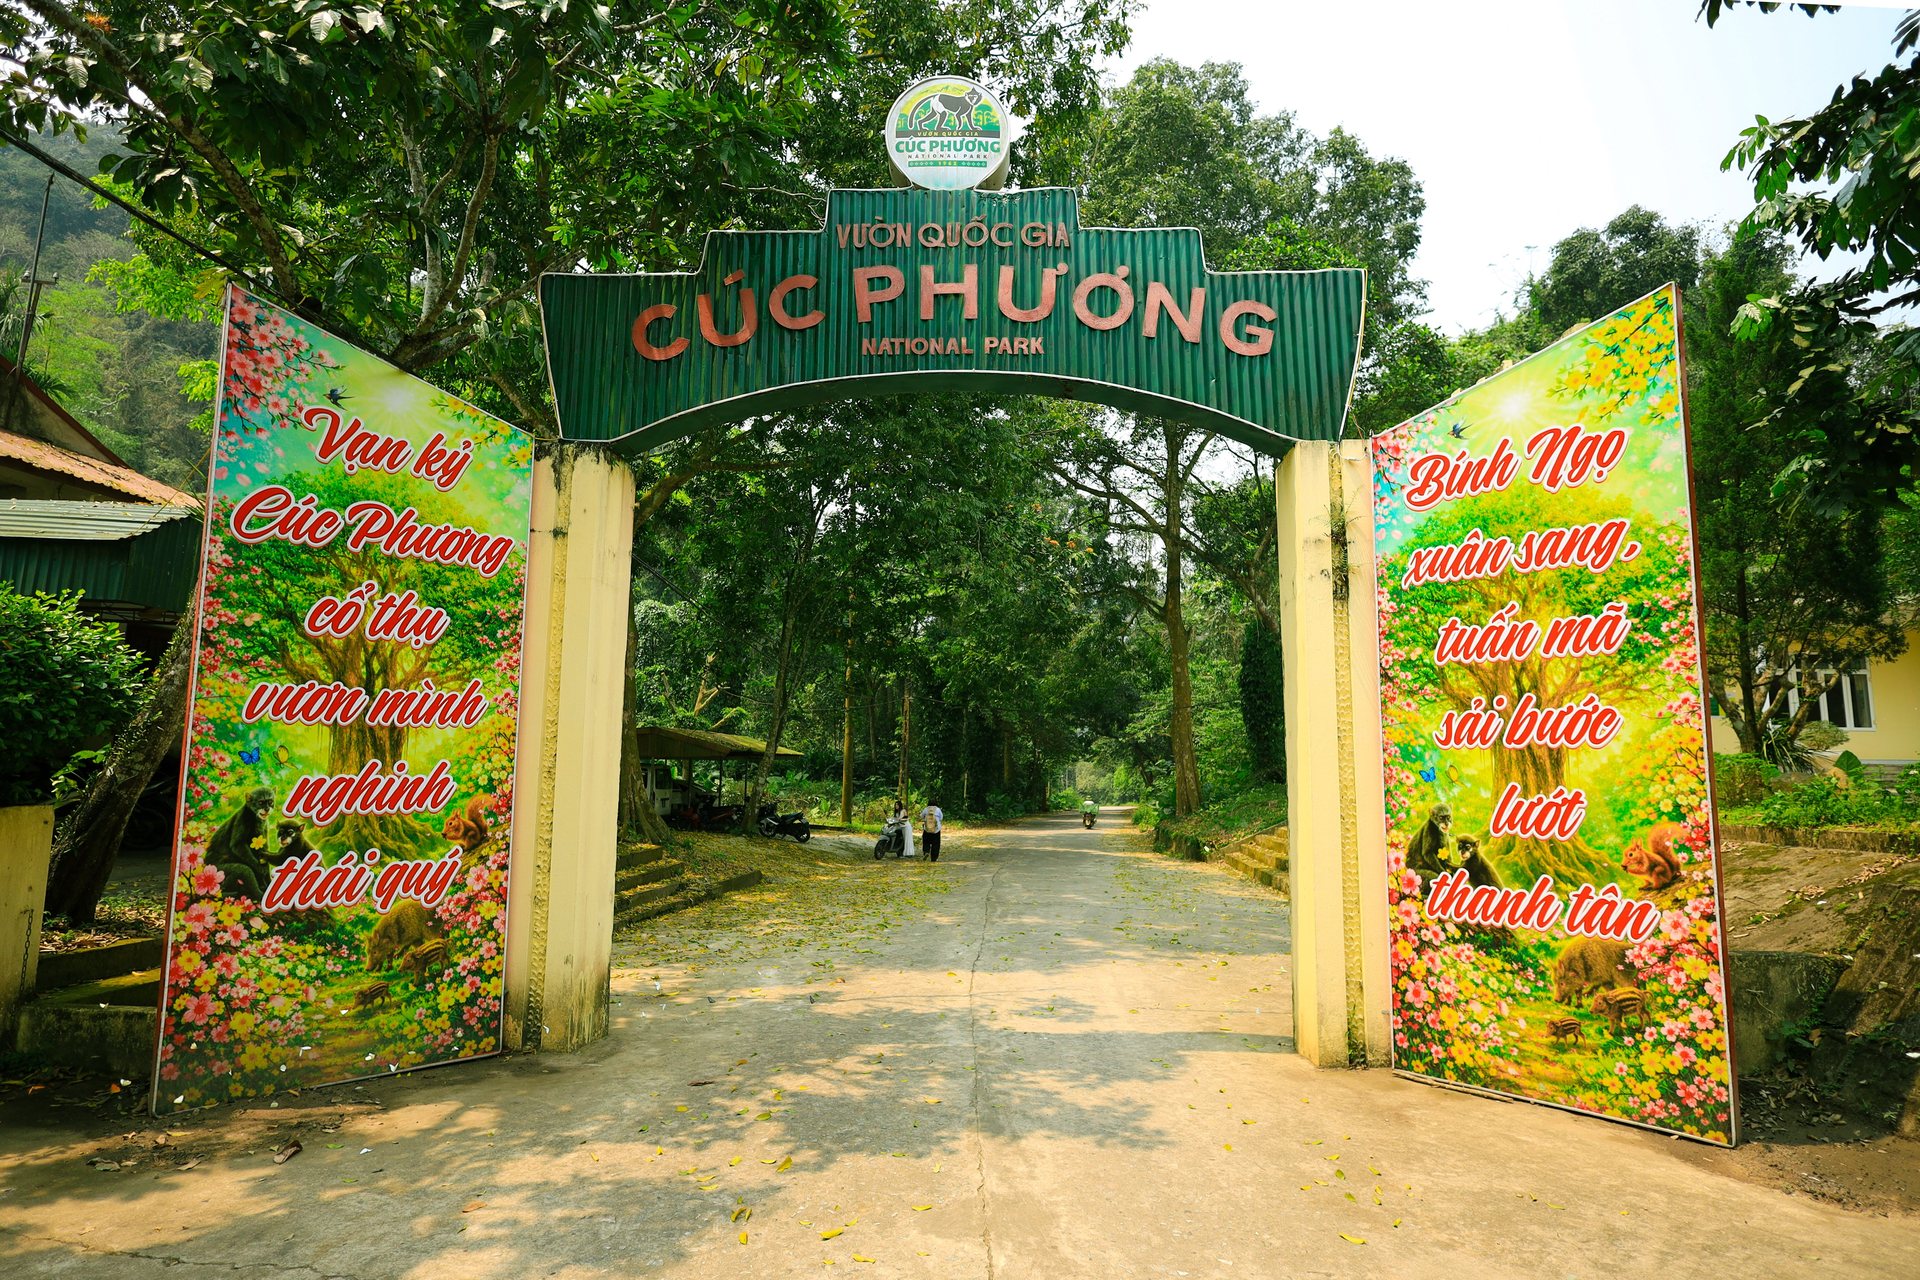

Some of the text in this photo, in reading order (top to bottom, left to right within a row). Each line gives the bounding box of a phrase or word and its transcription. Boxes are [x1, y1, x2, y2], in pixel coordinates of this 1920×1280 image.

[895, 136, 1000, 153] CÚC PHƯƠNG
[837, 214, 1070, 249] VƯỜN QUỐC GIA
[631, 262, 1277, 361] CÚC PHƯƠNG
[862, 336, 1044, 356] NATIONAL PARK
[303, 408, 472, 490] Vạn kỷ
[1406, 426, 1628, 510] Bính Ngọ
[232, 487, 514, 576] Cúc Phương
[1404, 520, 1640, 588] xuân sang,
[306, 582, 448, 648] cổ thụ
[1437, 602, 1630, 664] tuấn mã
[245, 681, 487, 726] vươn mình
[1435, 695, 1622, 747] sải bước
[284, 761, 455, 824] nghinh
[1492, 784, 1585, 838] lướt
[264, 847, 461, 911] thái quý
[1427, 870, 1660, 941] thanh tân
